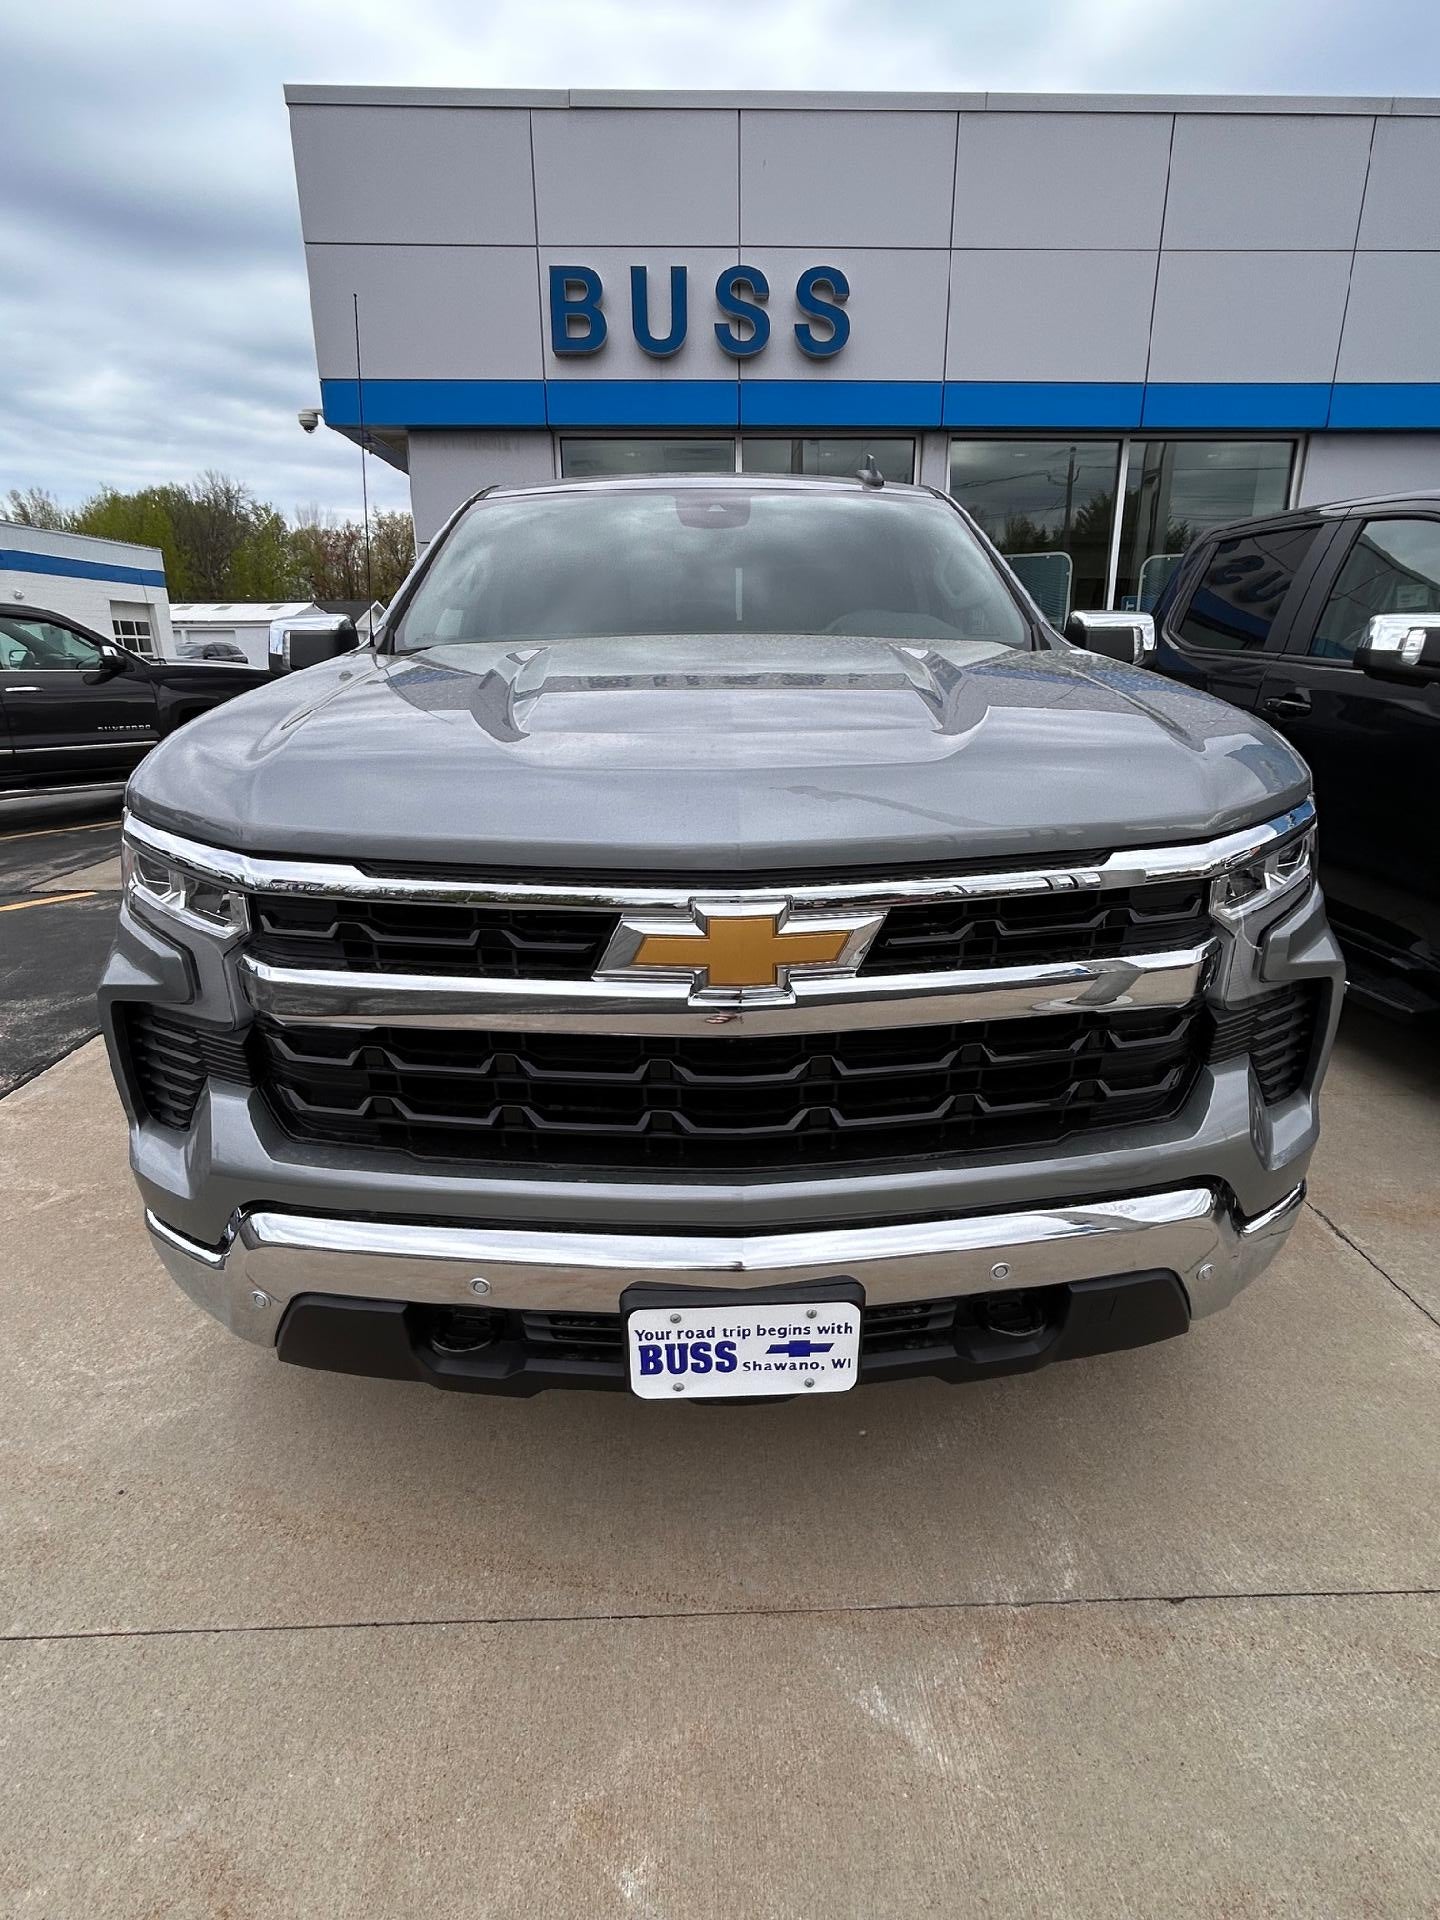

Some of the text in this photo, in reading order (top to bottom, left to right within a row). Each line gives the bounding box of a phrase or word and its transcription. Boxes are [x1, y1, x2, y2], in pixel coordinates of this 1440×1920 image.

[549, 265, 850, 358] BUSS
[635, 1322, 853, 1341] Your road trip begins with
[638, 1340, 738, 1375] BUSS
[743, 1358, 851, 1371] Shawano, WI
